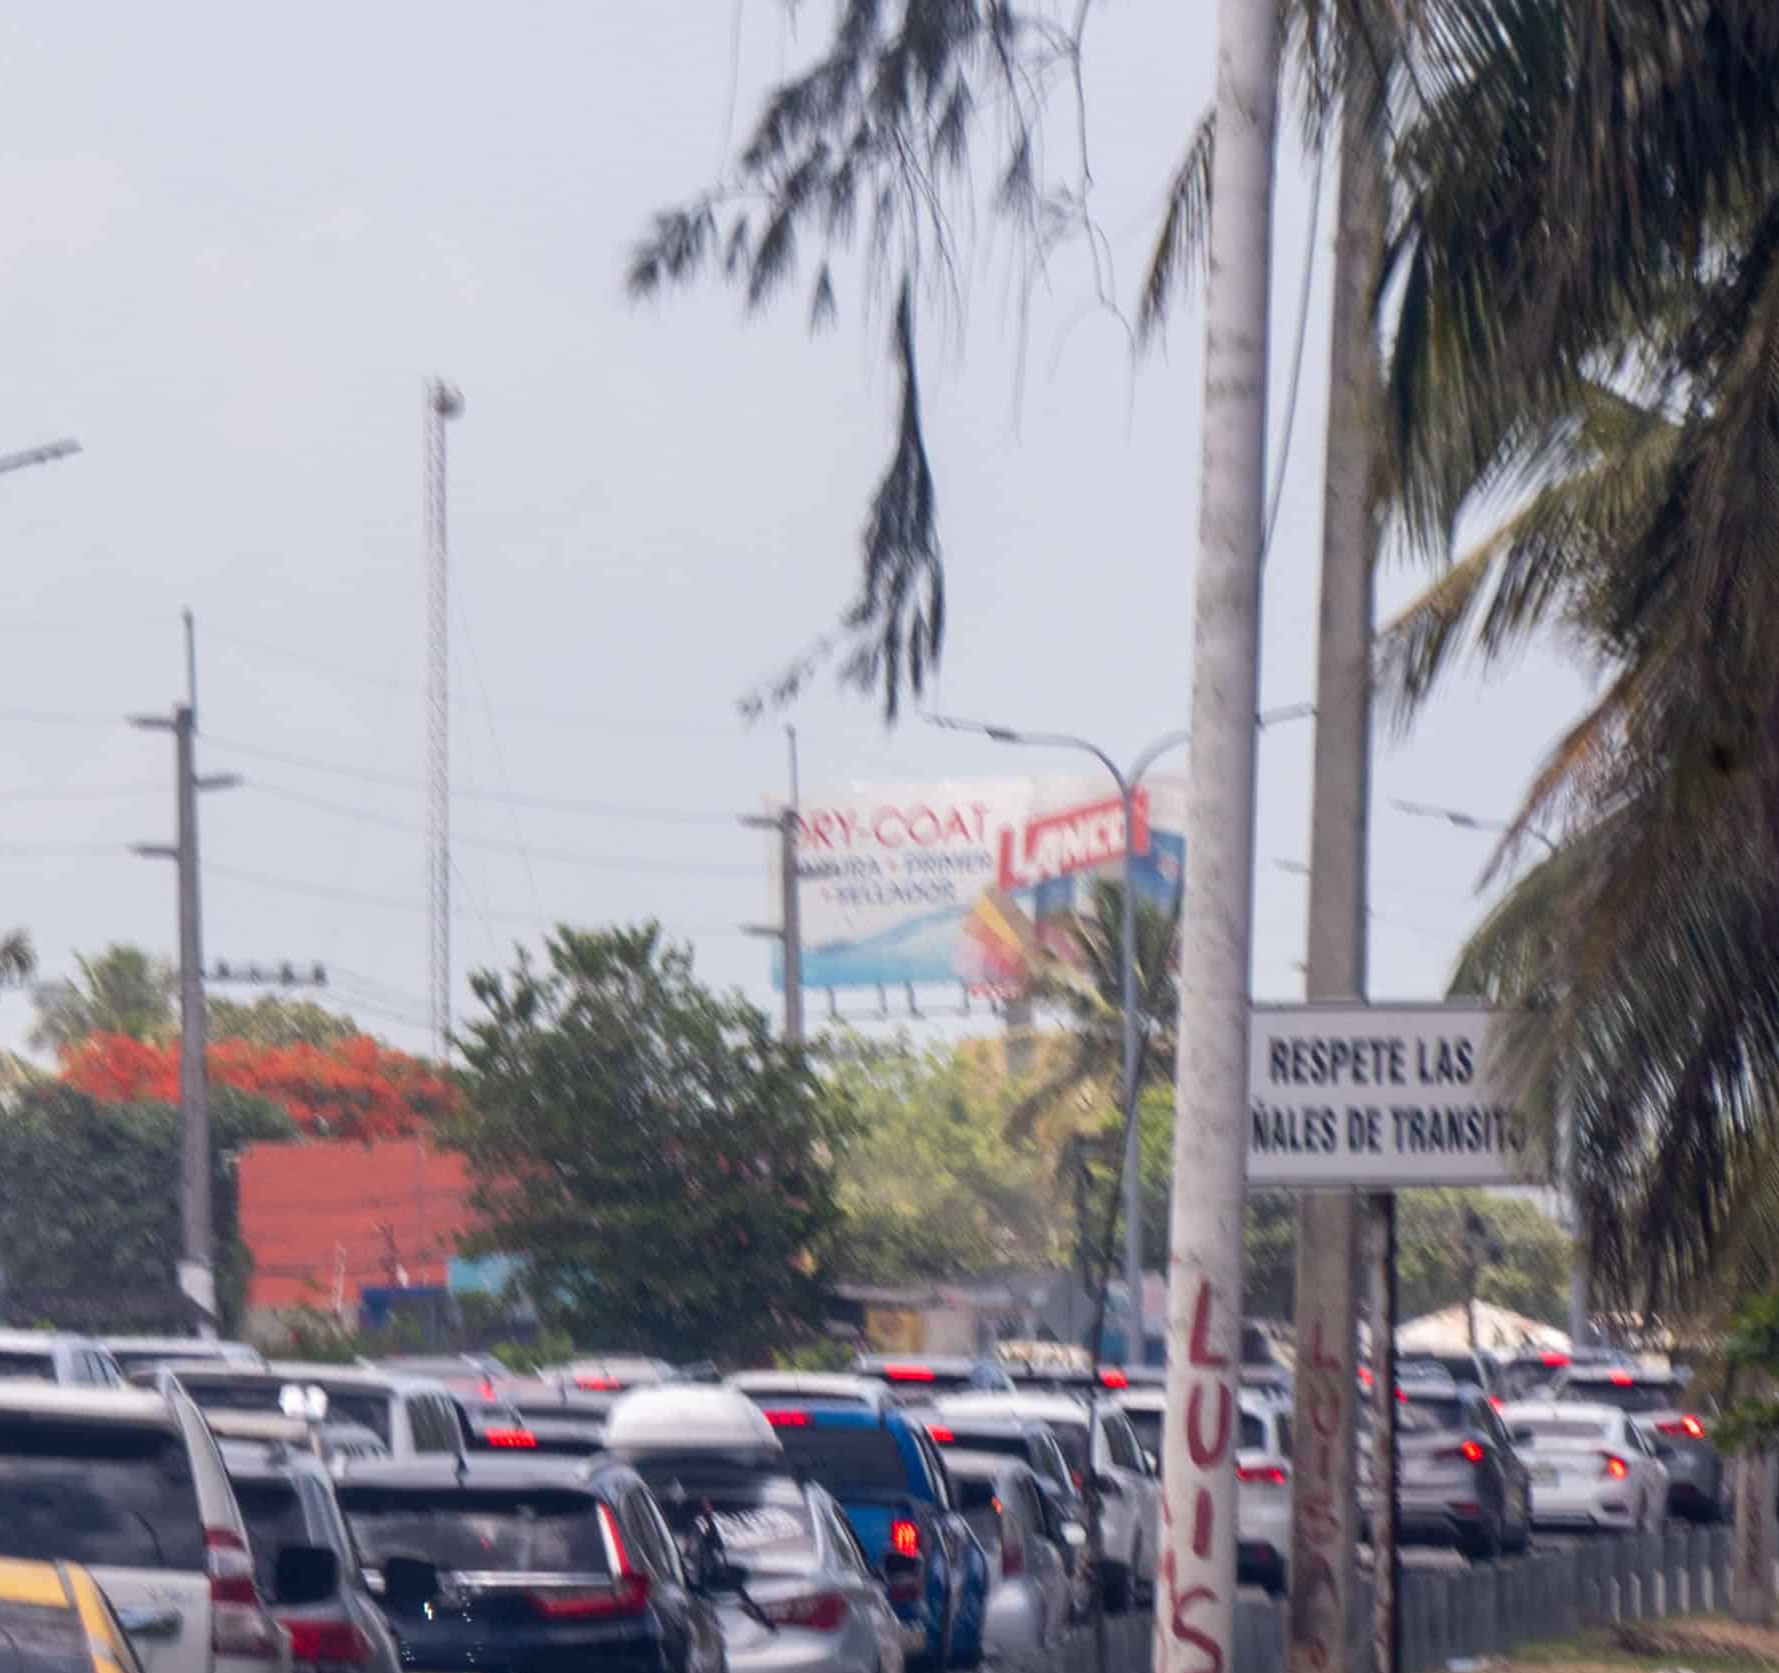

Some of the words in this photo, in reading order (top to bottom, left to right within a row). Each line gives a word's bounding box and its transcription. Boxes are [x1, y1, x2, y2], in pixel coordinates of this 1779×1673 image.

[1268, 1036, 1407, 1085] RESPETE
[1415, 1036, 1474, 1085] LAS
[1346, 1105, 1382, 1152] DE
